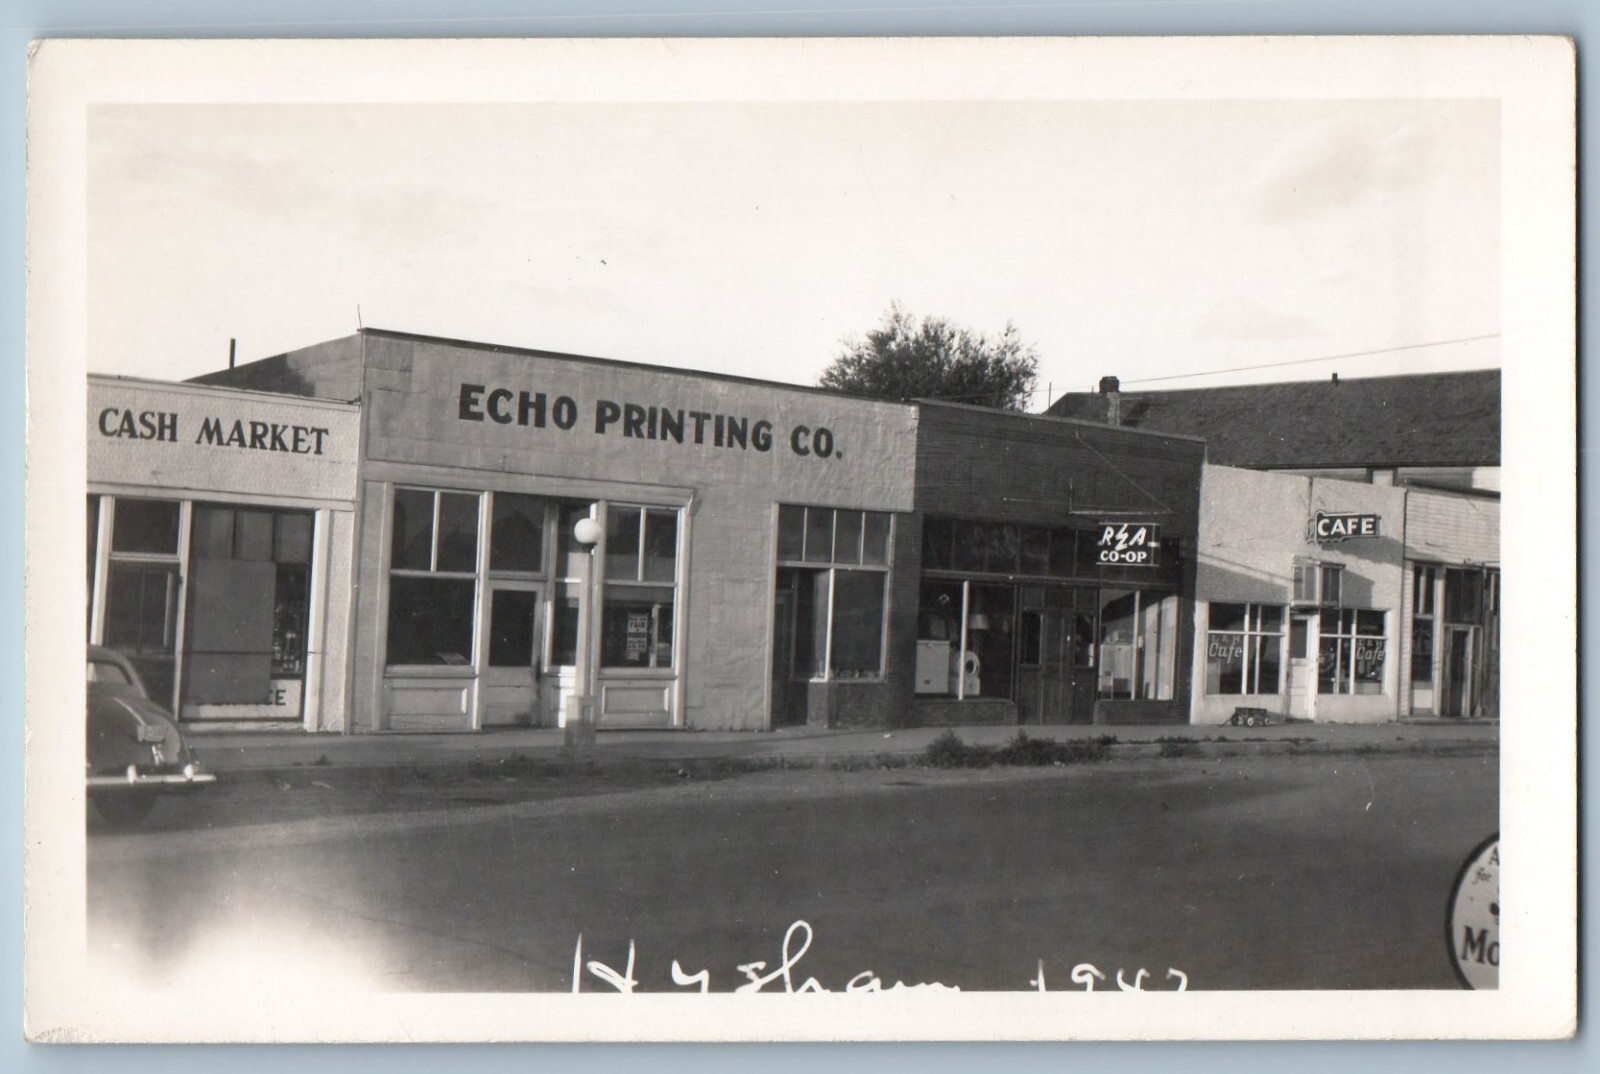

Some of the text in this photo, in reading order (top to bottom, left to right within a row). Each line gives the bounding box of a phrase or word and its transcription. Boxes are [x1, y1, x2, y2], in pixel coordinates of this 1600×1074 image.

[99, 407, 330, 455] CASH MARKET
[458, 383, 843, 460] ECHO PRINTING CO.
[1317, 516, 1375, 536] CAFE
[1100, 550, 1147, 563] CO-OP
[1208, 641, 1243, 665] Cafe
[1356, 646, 1385, 665] Cafe
